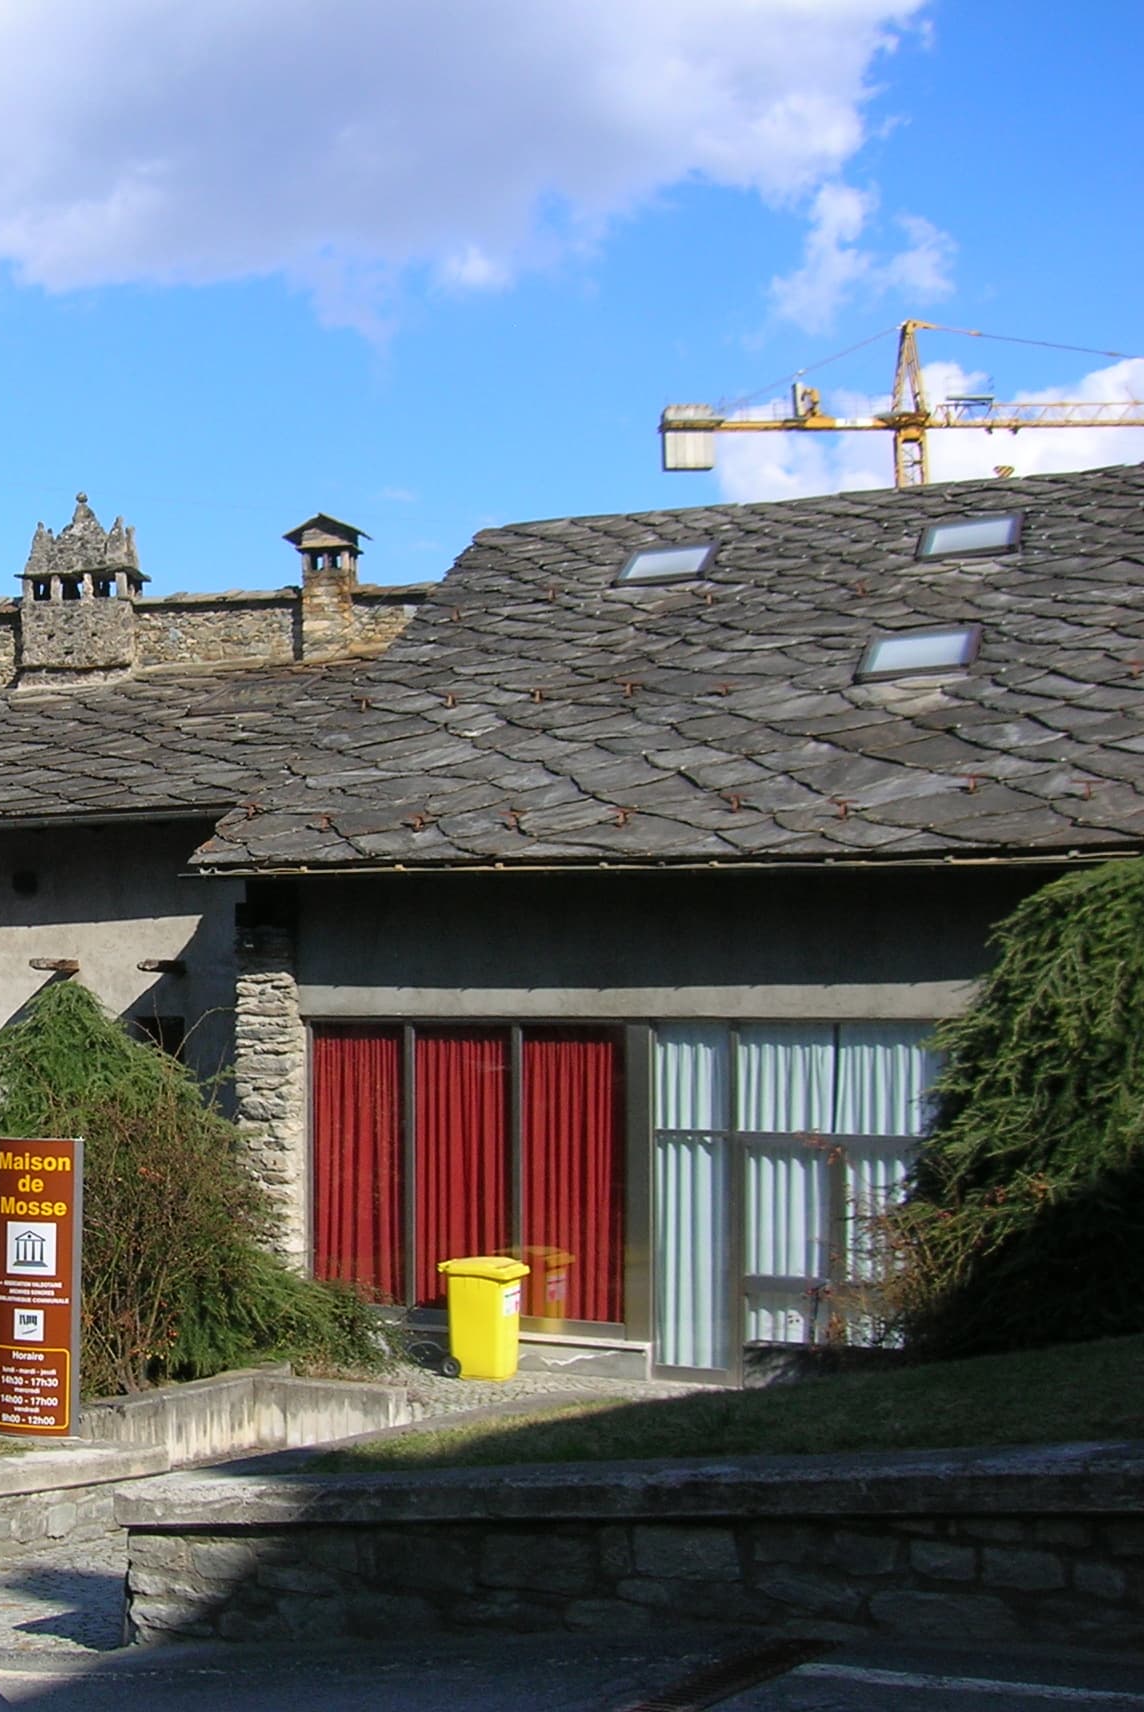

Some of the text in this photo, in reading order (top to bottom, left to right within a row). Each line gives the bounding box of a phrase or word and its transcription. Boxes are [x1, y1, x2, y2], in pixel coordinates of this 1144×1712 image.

[18, 1174, 44, 1193] de
[0, 1196, 67, 1216] Mosse
[12, 1350, 44, 1361] Horaire
[1, 1375, 24, 1386] 14h30
[30, 1377, 59, 1387] 17h30
[0, 1394, 23, 1405] 14h00
[30, 1397, 59, 1407] 17h00
[27, 1416, 56, 1426] 12h00
